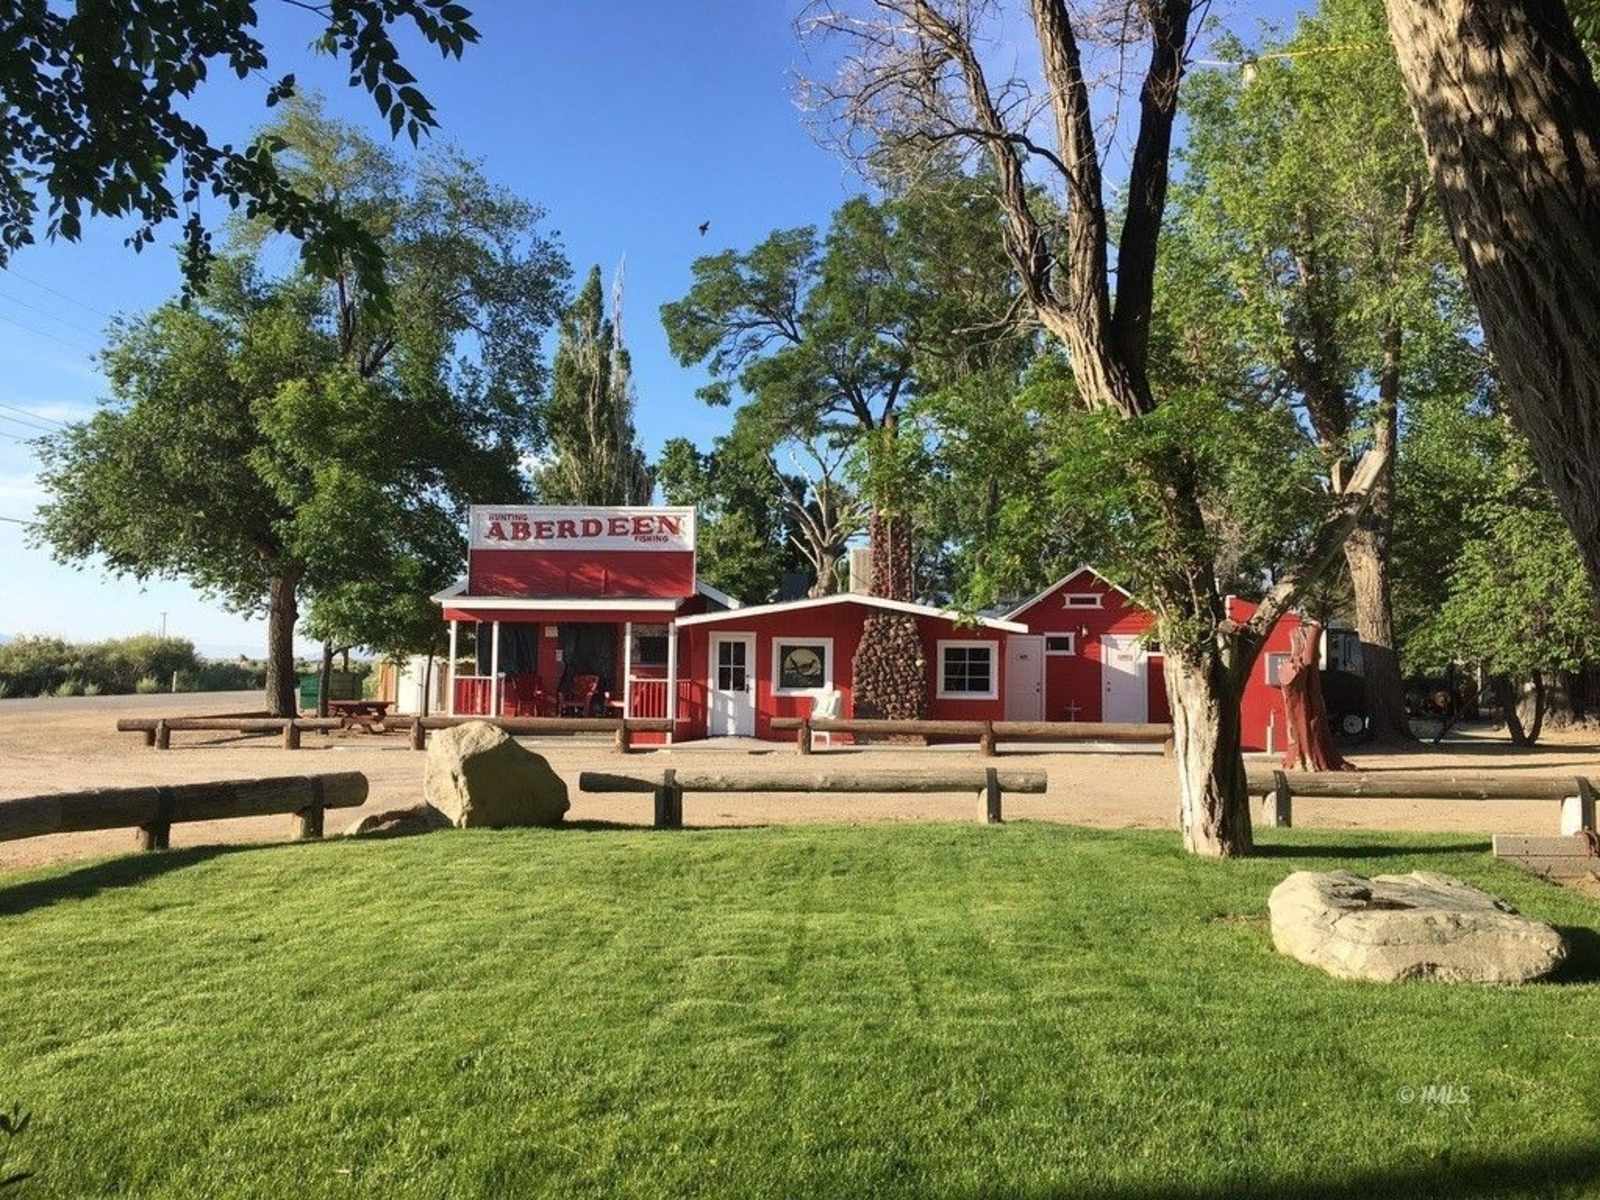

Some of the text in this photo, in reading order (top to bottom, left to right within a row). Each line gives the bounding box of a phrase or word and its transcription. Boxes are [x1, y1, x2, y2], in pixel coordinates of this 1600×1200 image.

[488, 512, 529, 521] HUNTING
[484, 515, 682, 541] ABERDEEN
[633, 534, 670, 544] FISHING
